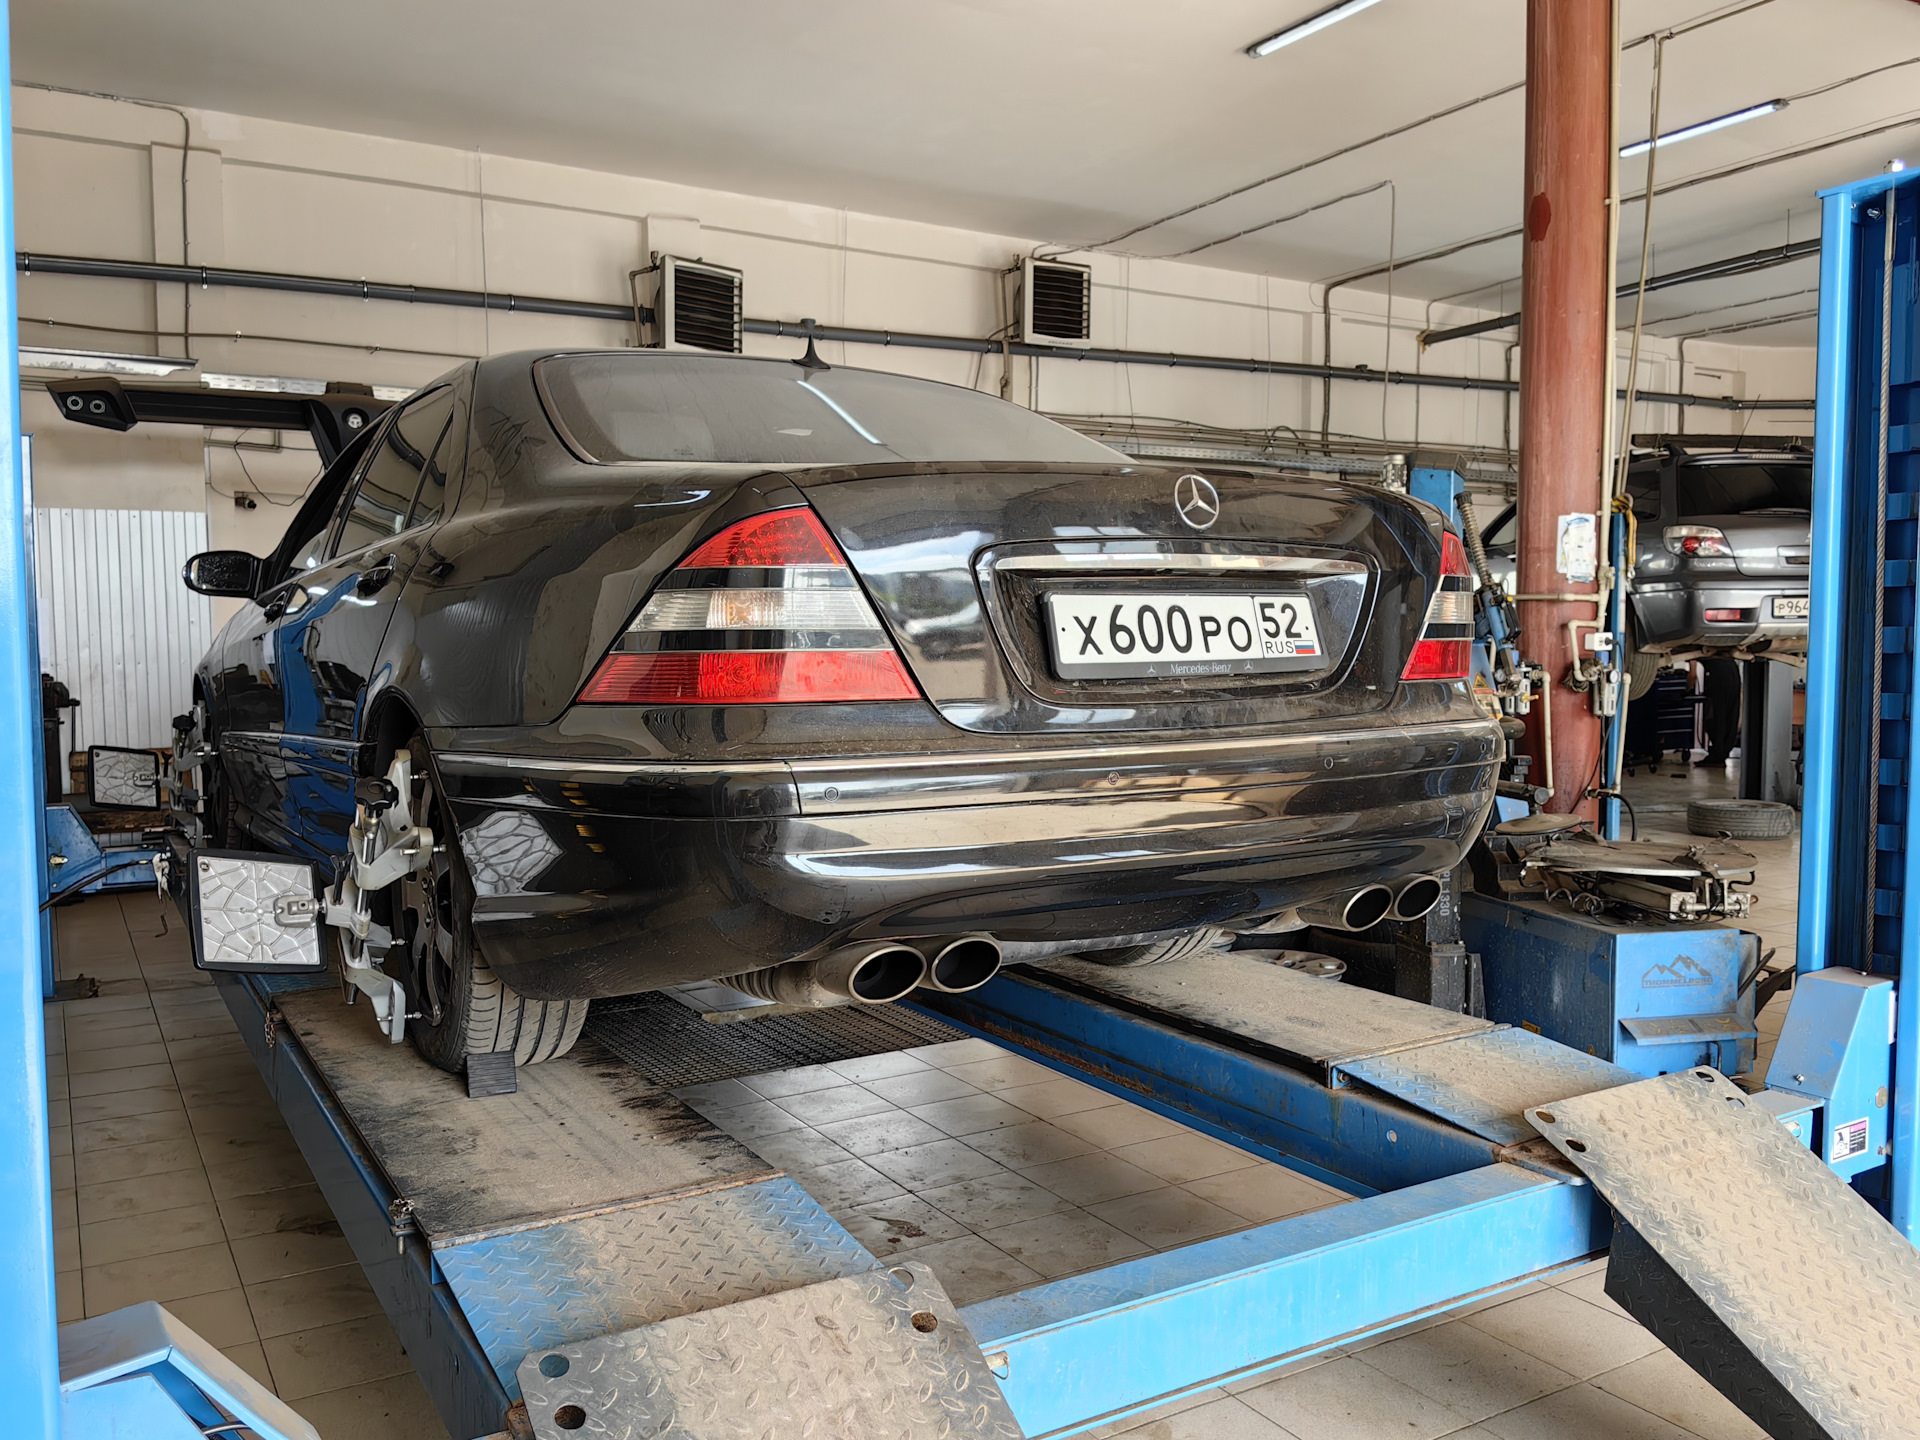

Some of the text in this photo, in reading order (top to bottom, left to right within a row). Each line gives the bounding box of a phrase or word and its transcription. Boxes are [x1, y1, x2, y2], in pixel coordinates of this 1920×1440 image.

[1259, 602, 1302, 639] 52
[1265, 640, 1295, 655] RUS
[1170, 662, 1232, 675] Mercedes-Benz
